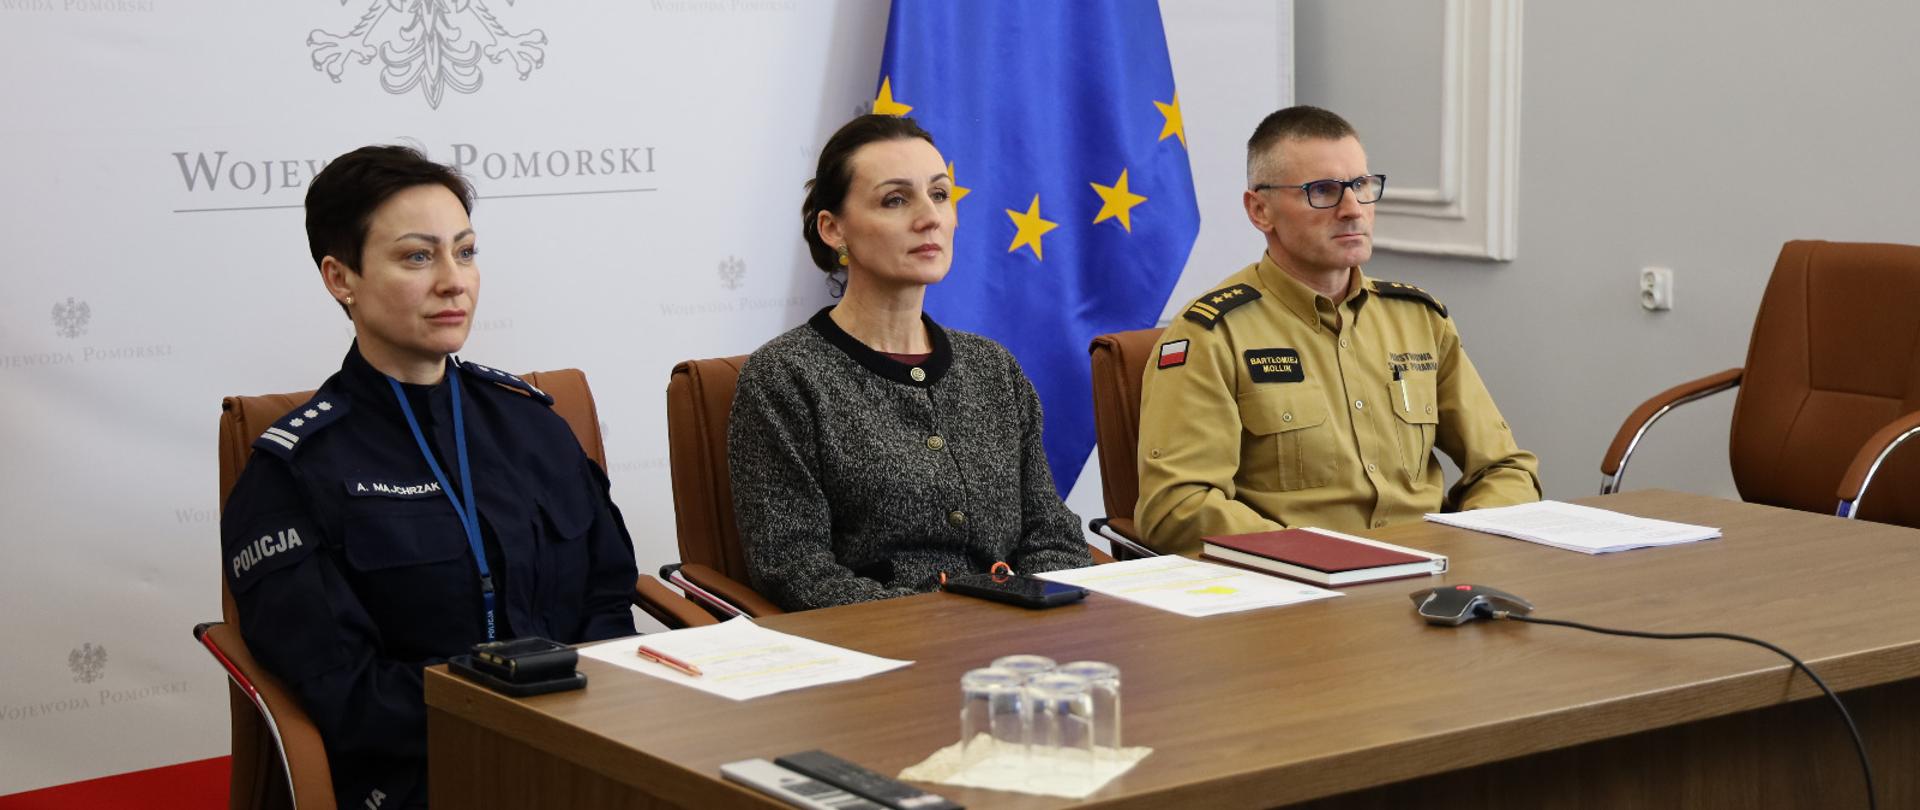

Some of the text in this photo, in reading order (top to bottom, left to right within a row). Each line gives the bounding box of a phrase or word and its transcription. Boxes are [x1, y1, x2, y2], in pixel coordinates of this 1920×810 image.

[451, 143, 656, 180] POMORSKI
[373, 482, 440, 495] MAJCHRZAK
[232, 527, 303, 578] POLICJA
